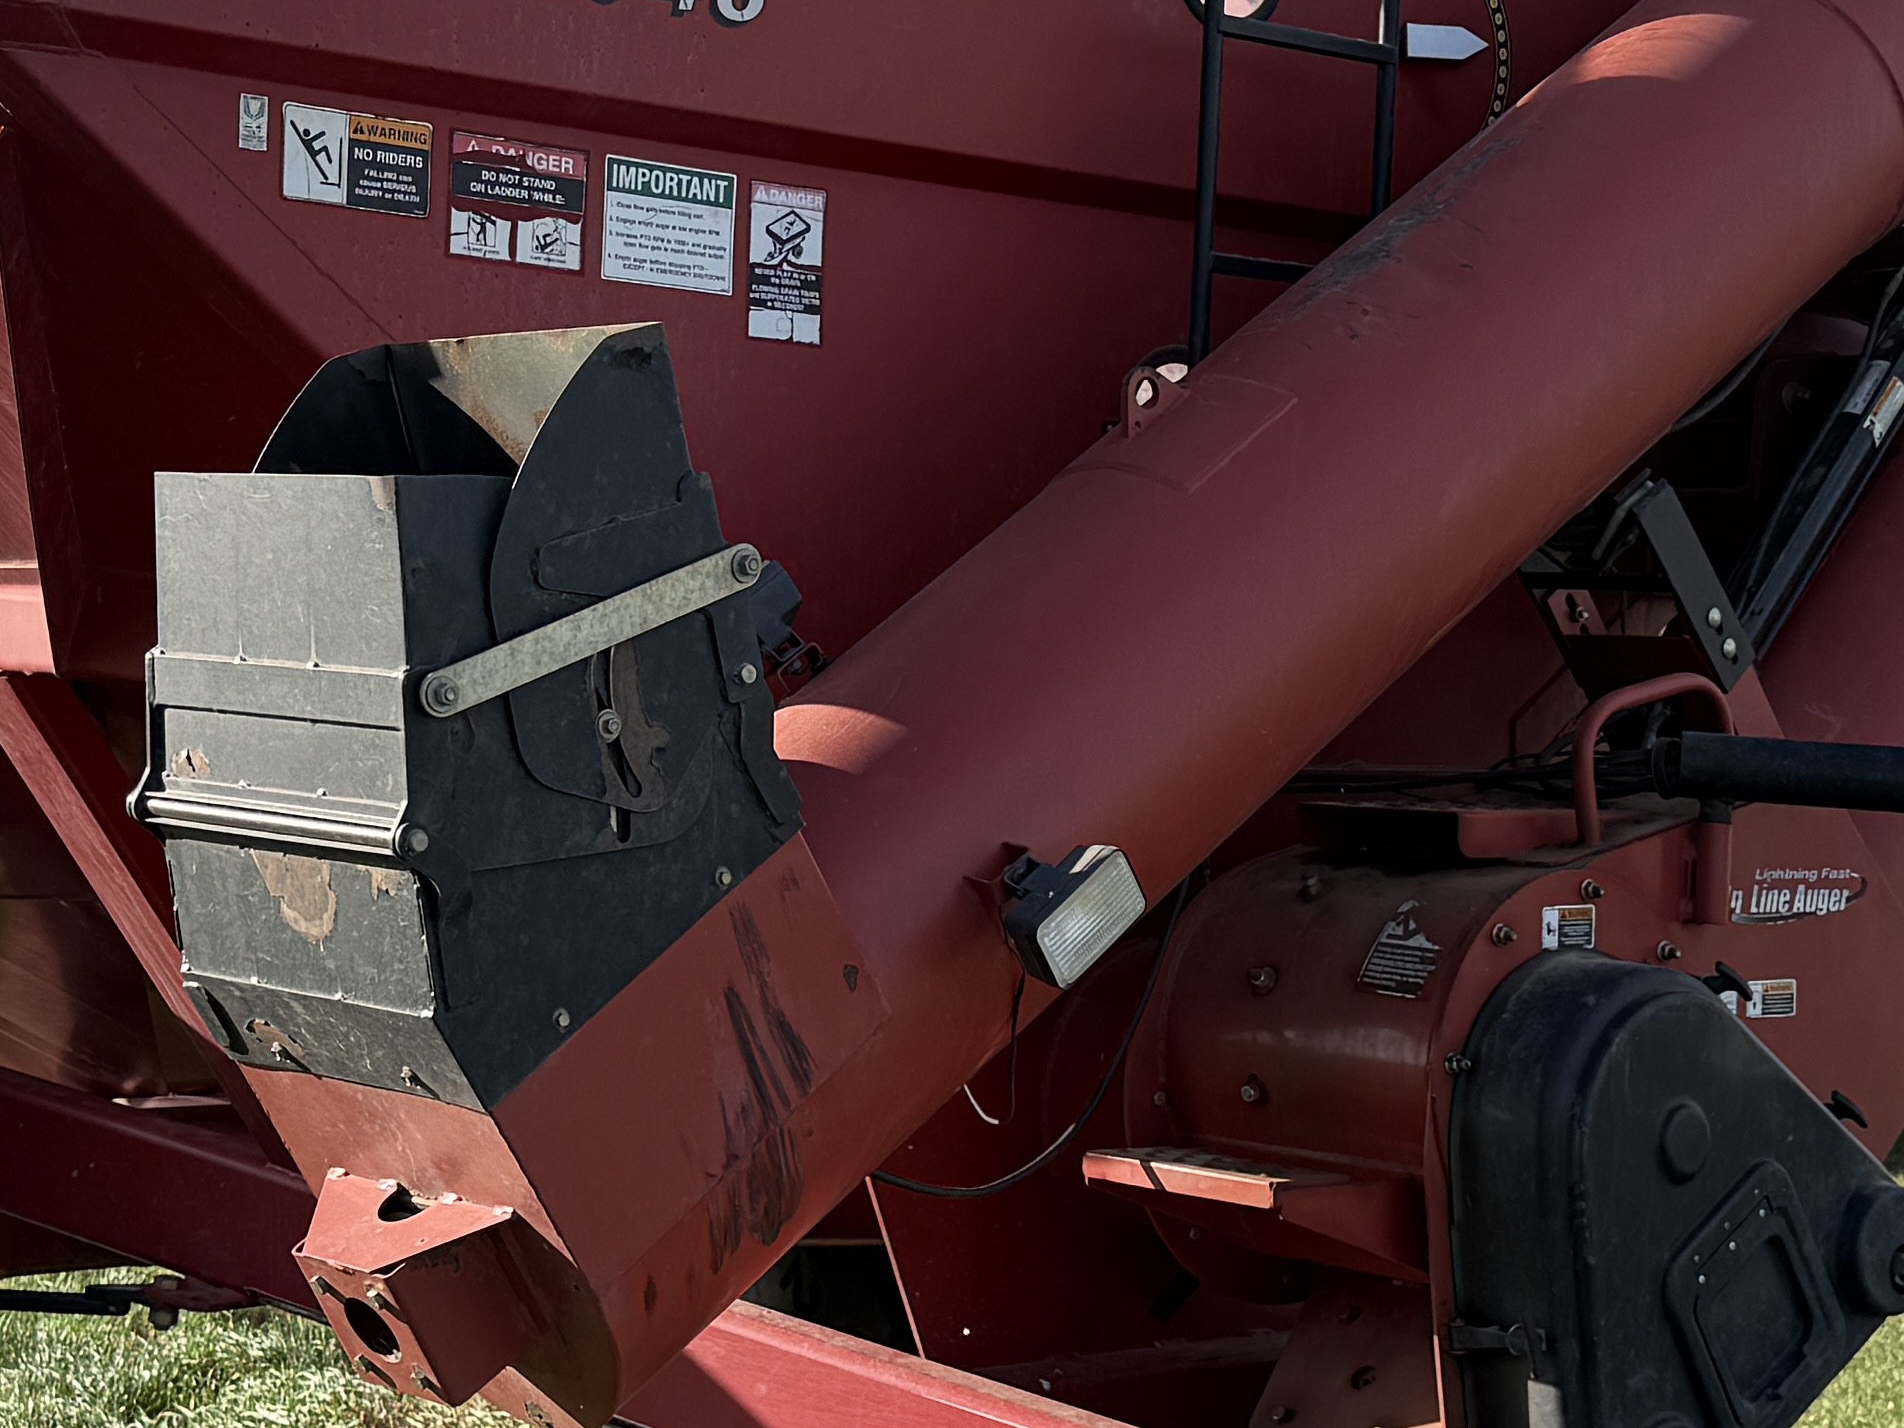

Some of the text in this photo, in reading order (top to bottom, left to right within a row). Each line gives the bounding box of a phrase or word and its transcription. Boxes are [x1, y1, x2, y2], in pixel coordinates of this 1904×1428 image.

[366, 124, 428, 145] WARNING
[354, 147, 423, 169] NO RIDERS
[470, 181, 485, 193] ON
[487, 184, 529, 199] LADDER
[481, 170, 556, 190] DO NOT STAND
[612, 163, 728, 203] IMPORTANT
[770, 188, 824, 210] DANGER
[1755, 867, 1851, 882] Lightning Fast
[1750, 884, 1791, 913] Line
[1792, 884, 1851, 916] Auger
